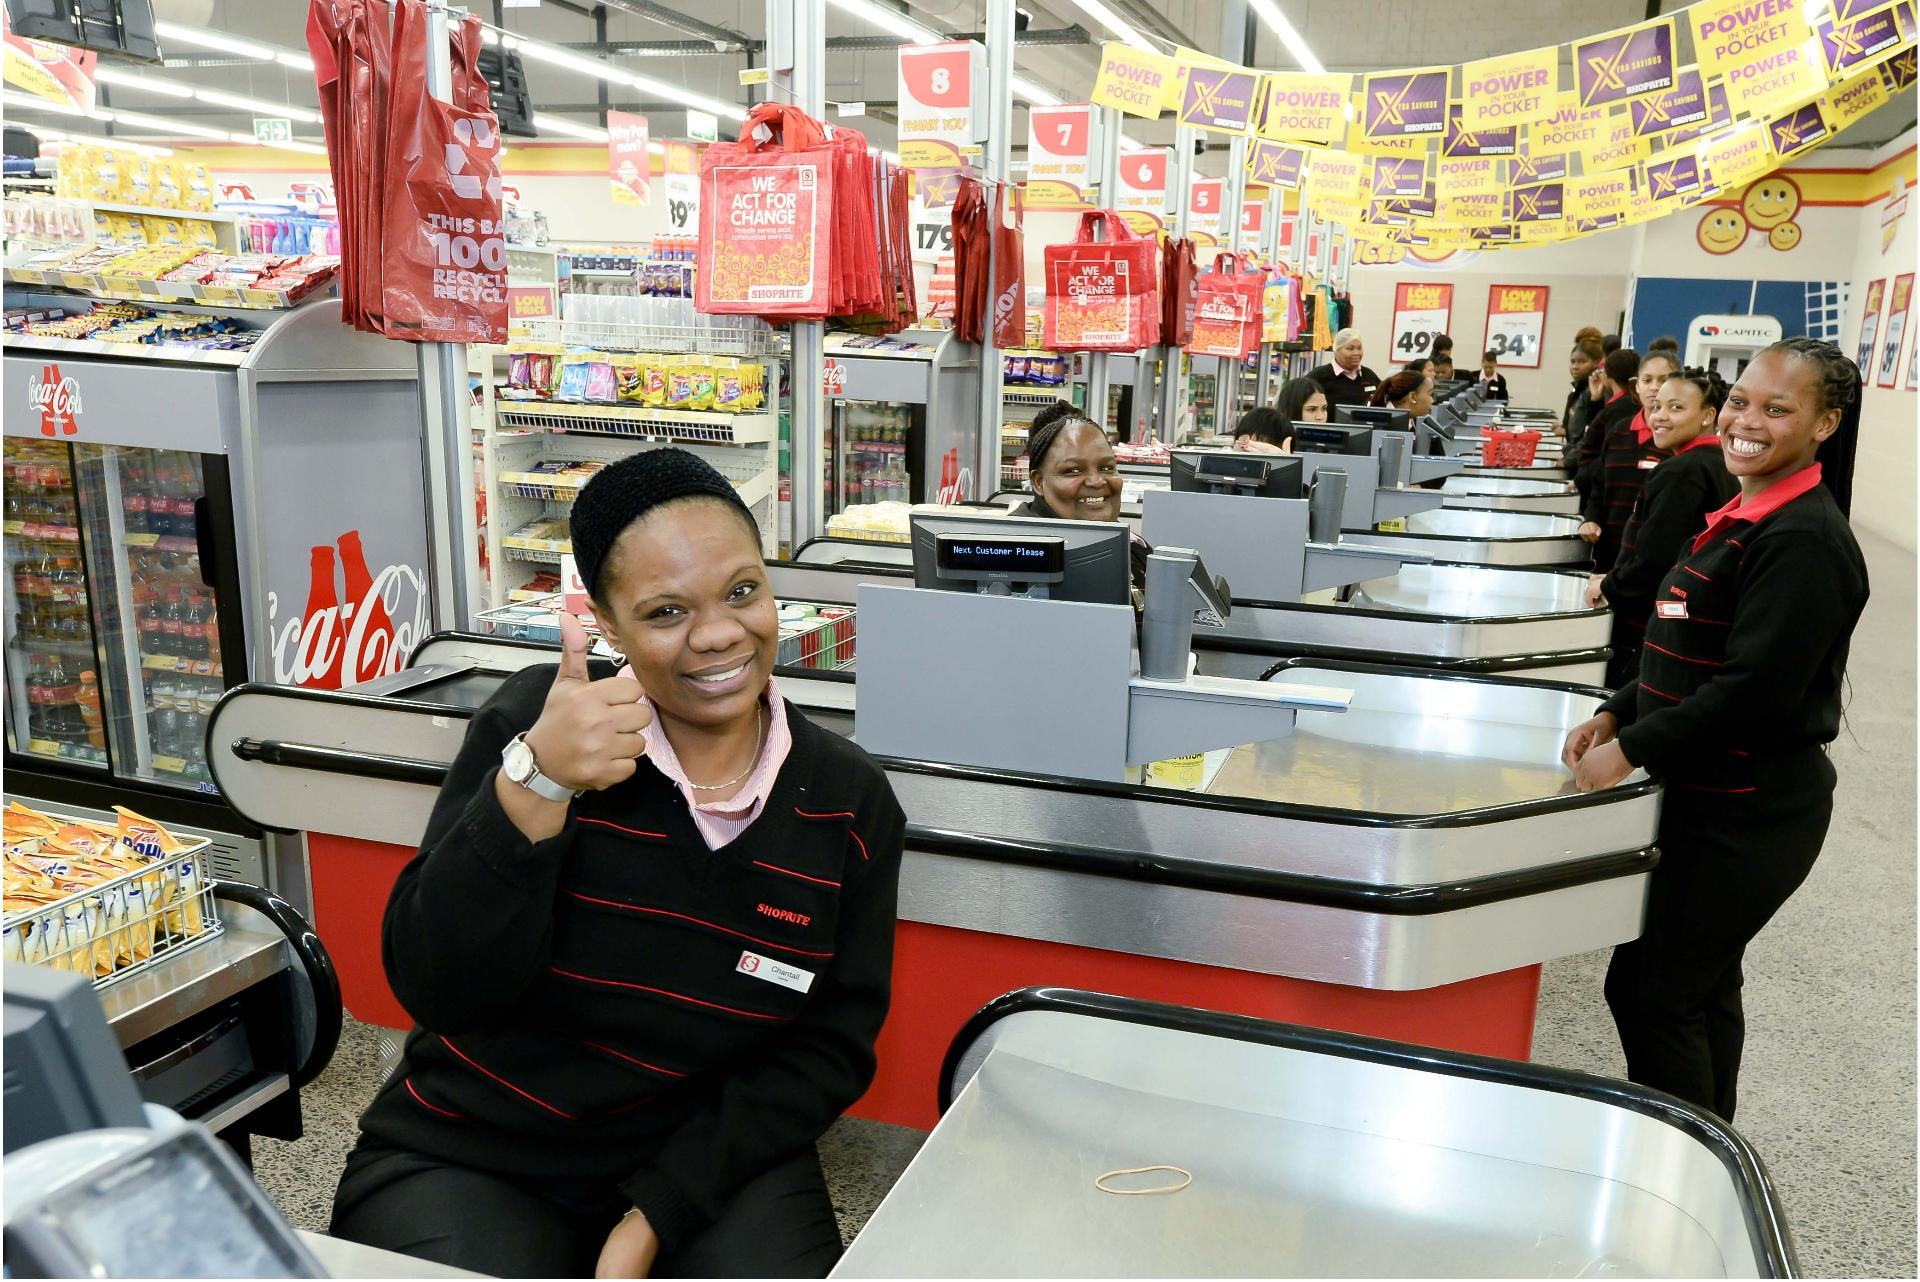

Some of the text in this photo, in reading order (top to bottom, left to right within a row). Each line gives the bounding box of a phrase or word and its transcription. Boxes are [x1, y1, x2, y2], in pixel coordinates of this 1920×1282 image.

[1700, 0, 1794, 40] POWER
[1715, 22, 1787, 60] POCKET
[1104, 60, 1163, 89] POWER
[1730, 49, 1798, 84] POWER
[930, 67, 951, 95] 8
[1470, 69, 1549, 98] POWER
[1626, 77, 1671, 95] SHOPRITE
[1742, 72, 1796, 101] POCKET
[1106, 84, 1152, 107] POCKET
[1275, 91, 1342, 108] POWER
[1833, 77, 1878, 109] POWER
[1479, 96, 1542, 119] POCKET
[1280, 116, 1332, 130] POCKET
[1056, 123, 1073, 147] 7
[1543, 128, 1597, 145] POCKET
[1592, 144, 1637, 164] POCKET
[1712, 140, 1758, 164] POWER
[1137, 163, 1153, 183] 6
[1312, 162, 1357, 176] POWER
[1441, 159, 1490, 175] POWER
[751, 176, 777, 192] WE
[1579, 183, 1625, 199] POWER
[731, 193, 797, 210] ACT FOR
[1196, 190, 1209, 207] 5
[1585, 198, 1622, 212] POCKET
[730, 209, 796, 226] CHANGE
[1456, 208, 1493, 218] POCKET
[427, 213, 476, 234] THIS
[1082, 265, 1100, 276] WE
[1068, 275, 1115, 287] ACT OR
[751, 289, 804, 299] SHOPRITE
[1068, 285, 1116, 296] CHANGE
[1407, 287, 1443, 299] LOW
[1501, 290, 1537, 301] LOW
[515, 295, 546, 306] LOW
[1406, 299, 1441, 309] PRICE
[1500, 300, 1535, 312] PRICE
[1724, 328, 1774, 338] CAPITEC
[29, 375, 83, 415] Coca-Cola
[953, 545, 1045, 558] Next Customer Please
[756, 902, 812, 927] SHOPRITE
[771, 965, 801, 981] Chantall
